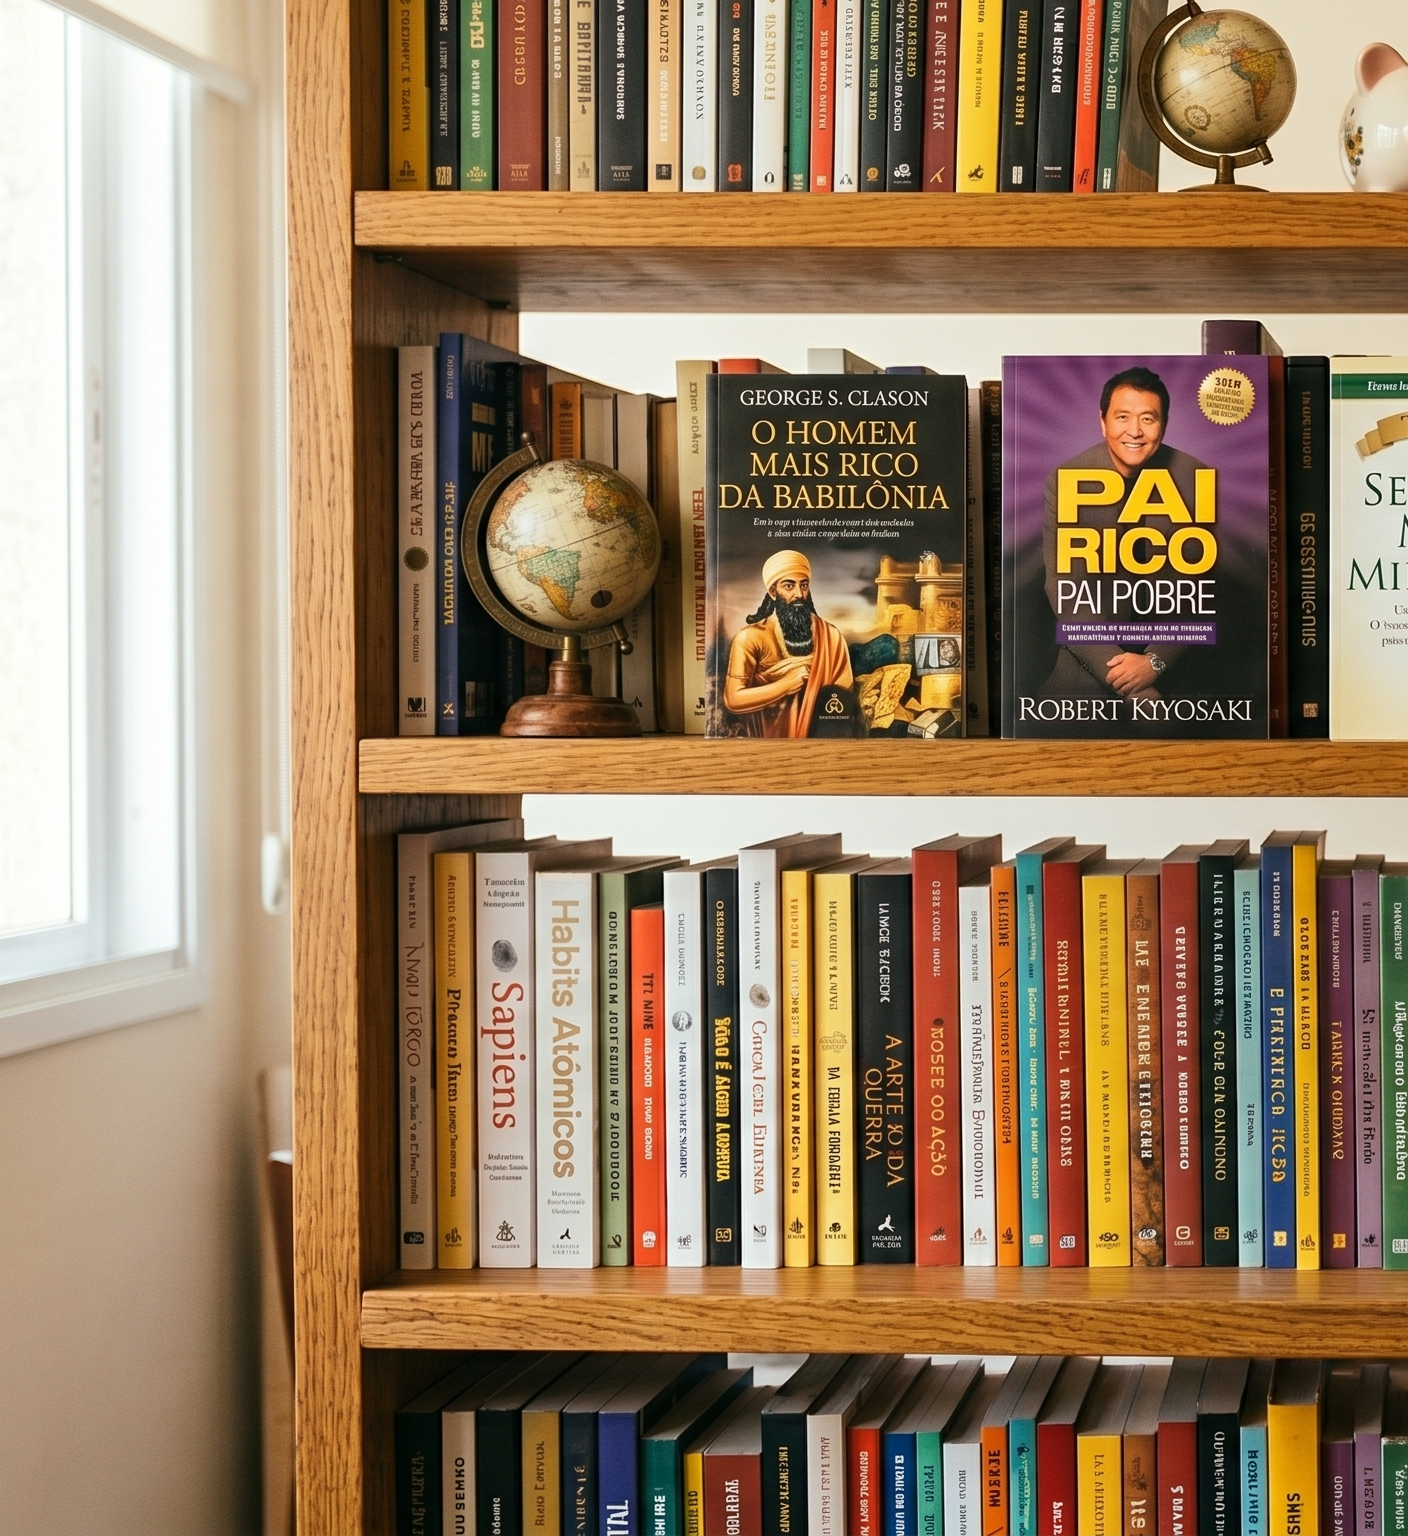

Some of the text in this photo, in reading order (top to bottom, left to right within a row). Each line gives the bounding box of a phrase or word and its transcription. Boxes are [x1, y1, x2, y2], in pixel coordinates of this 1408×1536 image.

[740, 389, 930, 407] GEORGE S. CLASON
[751, 420, 918, 446] O HOMEM
[750, 452, 920, 478] MAIS RICO
[719, 480, 950, 510] DA BABILÔNIA
[1057, 468, 1217, 524] PAI
[1056, 527, 1218, 575] RICO
[1057, 580, 1216, 615] PAI POBRE
[1018, 696, 1123, 721] ROBERT
[551, 900, 580, 1008] Habits
[481, 981, 527, 1129] Sapiens
[885, 1034, 903, 1050] A
[886, 1056, 904, 1115] ARTE
[863, 1068, 883, 1161] QUERRA
